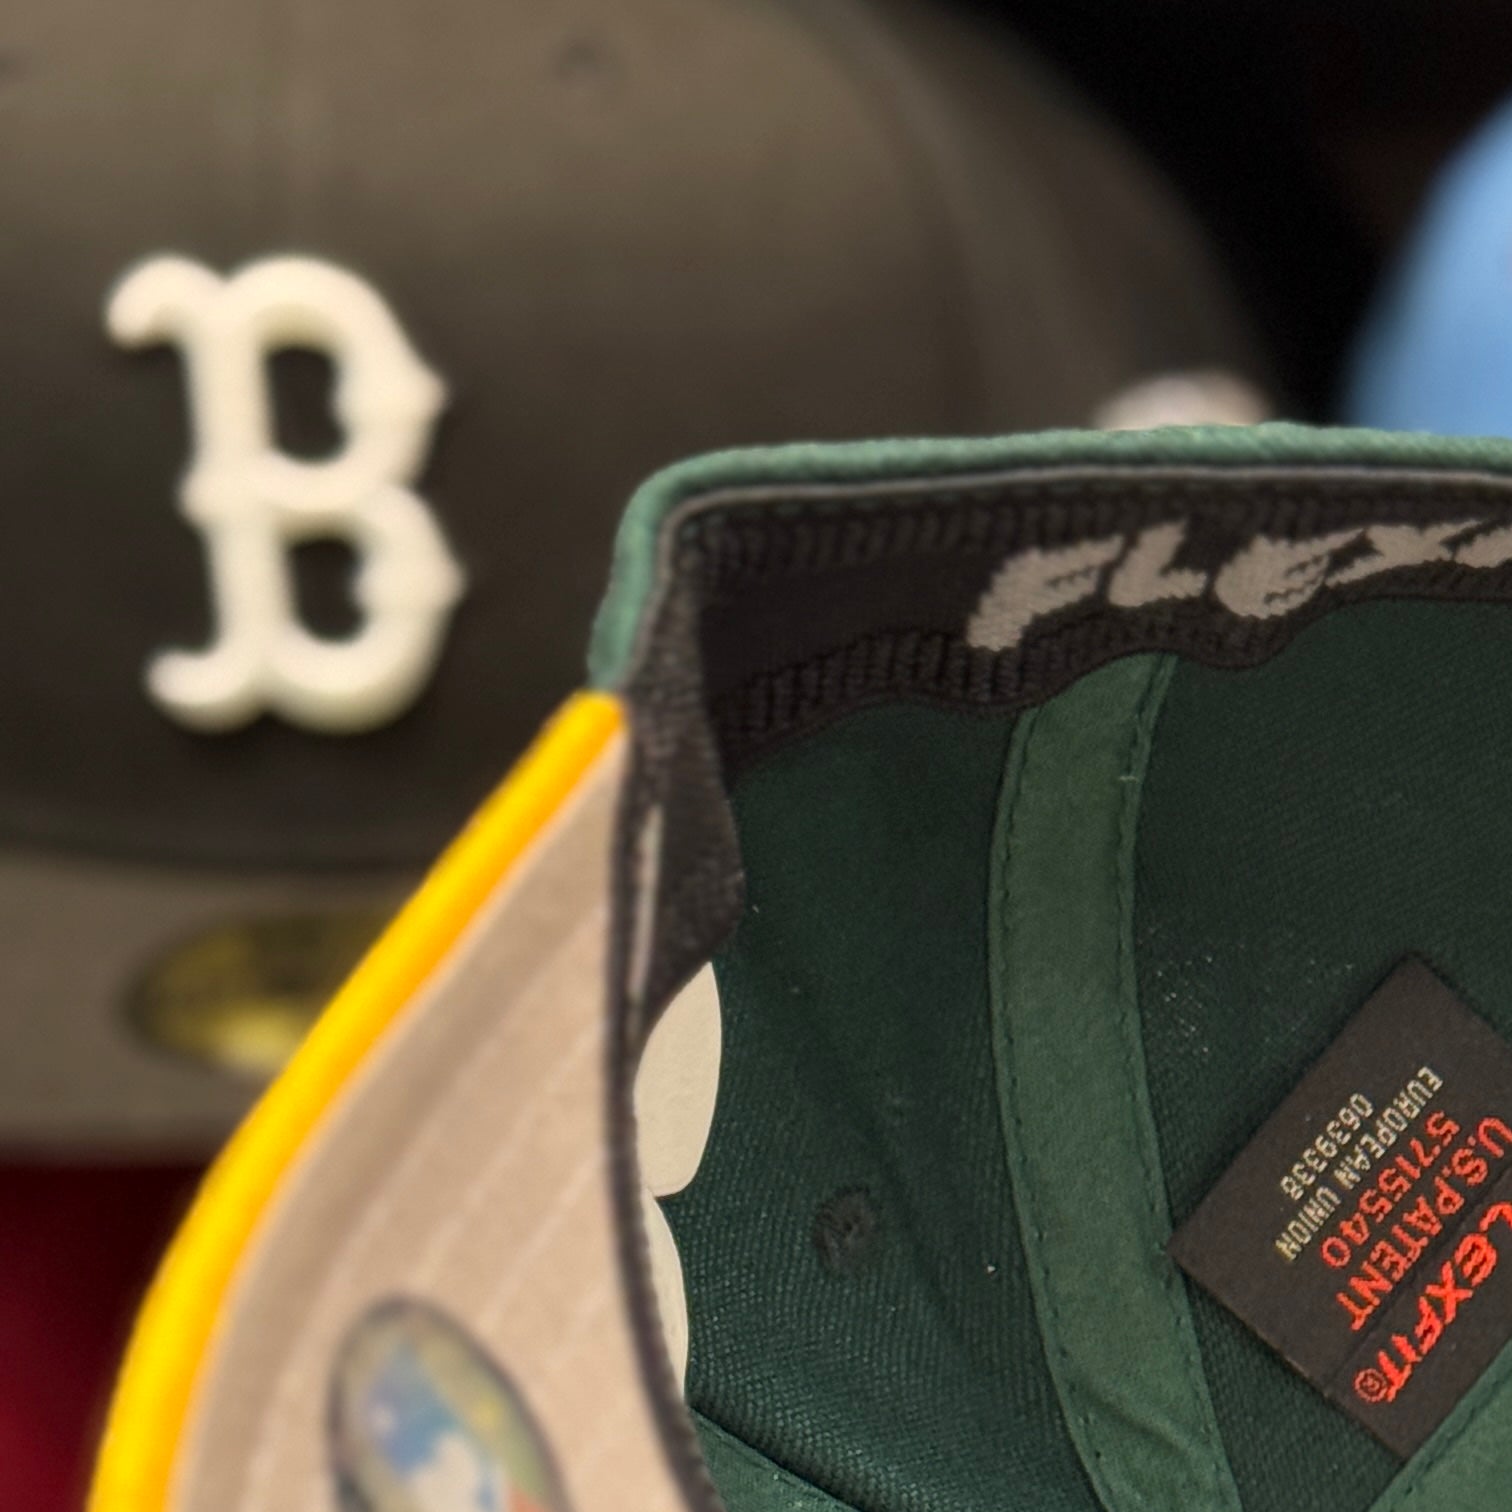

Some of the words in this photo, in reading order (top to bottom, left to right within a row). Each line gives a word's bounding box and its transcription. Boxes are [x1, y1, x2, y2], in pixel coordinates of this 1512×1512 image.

[105, 253, 464, 733] B
[1280, 1092, 1374, 1201] 0639338
[1320, 1110, 1461, 1268] 5715540
[1334, 1066, 1444, 1191] EUROPEAN
[1274, 1187, 1342, 1263] UNION
